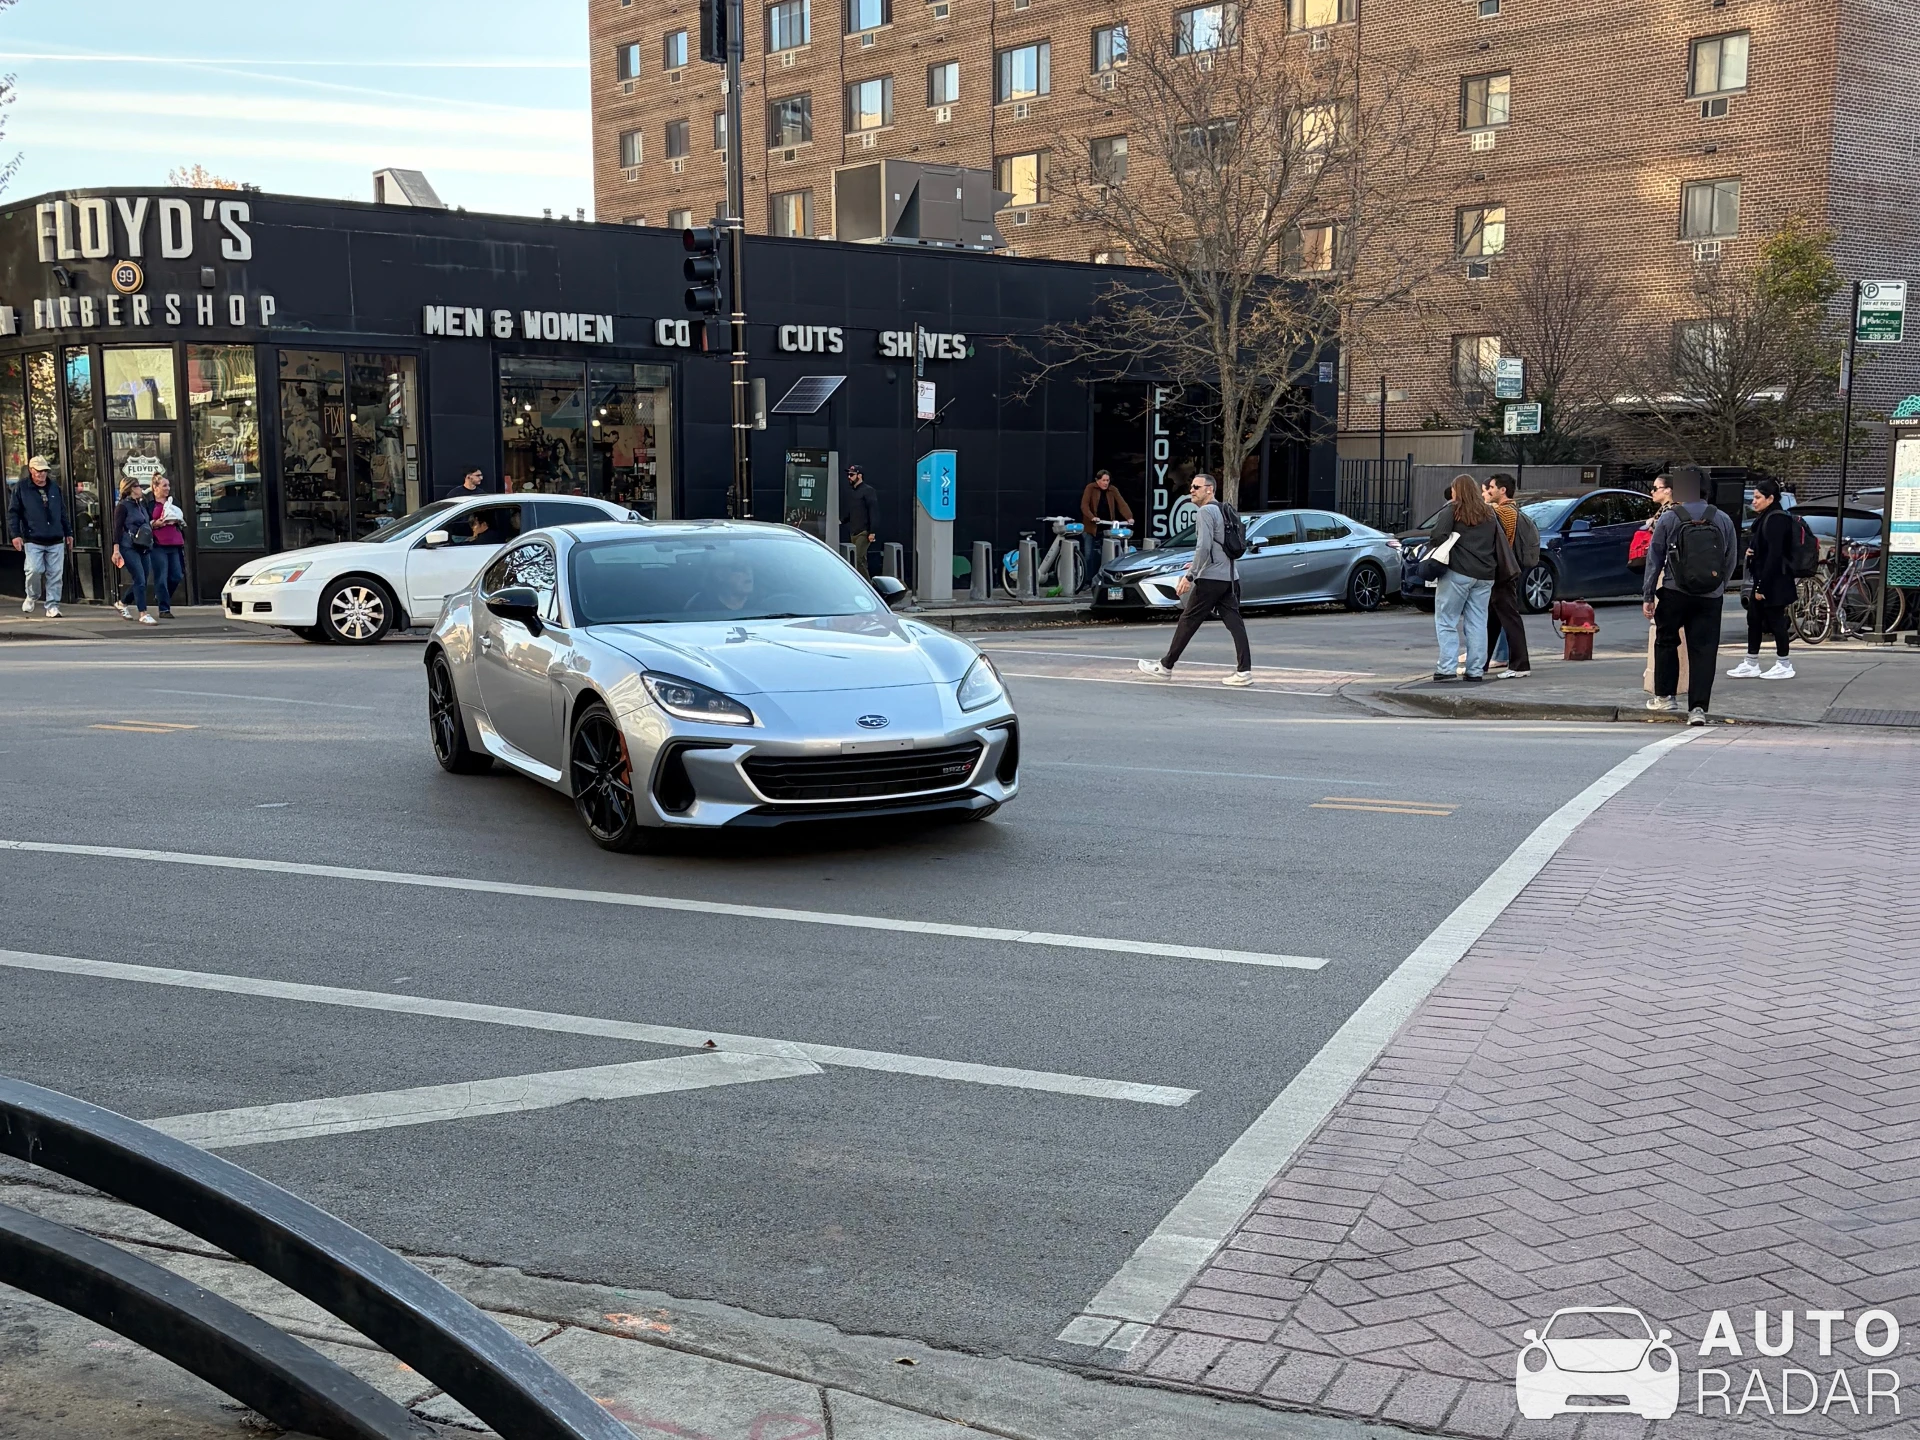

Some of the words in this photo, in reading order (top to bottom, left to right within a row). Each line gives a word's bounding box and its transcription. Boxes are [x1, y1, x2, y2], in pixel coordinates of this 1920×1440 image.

[36, 197, 252, 263] FLOYD'S
[118, 270, 134, 283] 99
[34, 293, 276, 330] BARBERSHOP
[424, 305, 484, 337] MEN
[491, 309, 514, 339] &
[520, 310, 614, 343] WOMEN
[778, 325, 844, 353] CUTS
[879, 331, 967, 360] SHVES
[1153, 388, 1170, 537] FLOYDS
